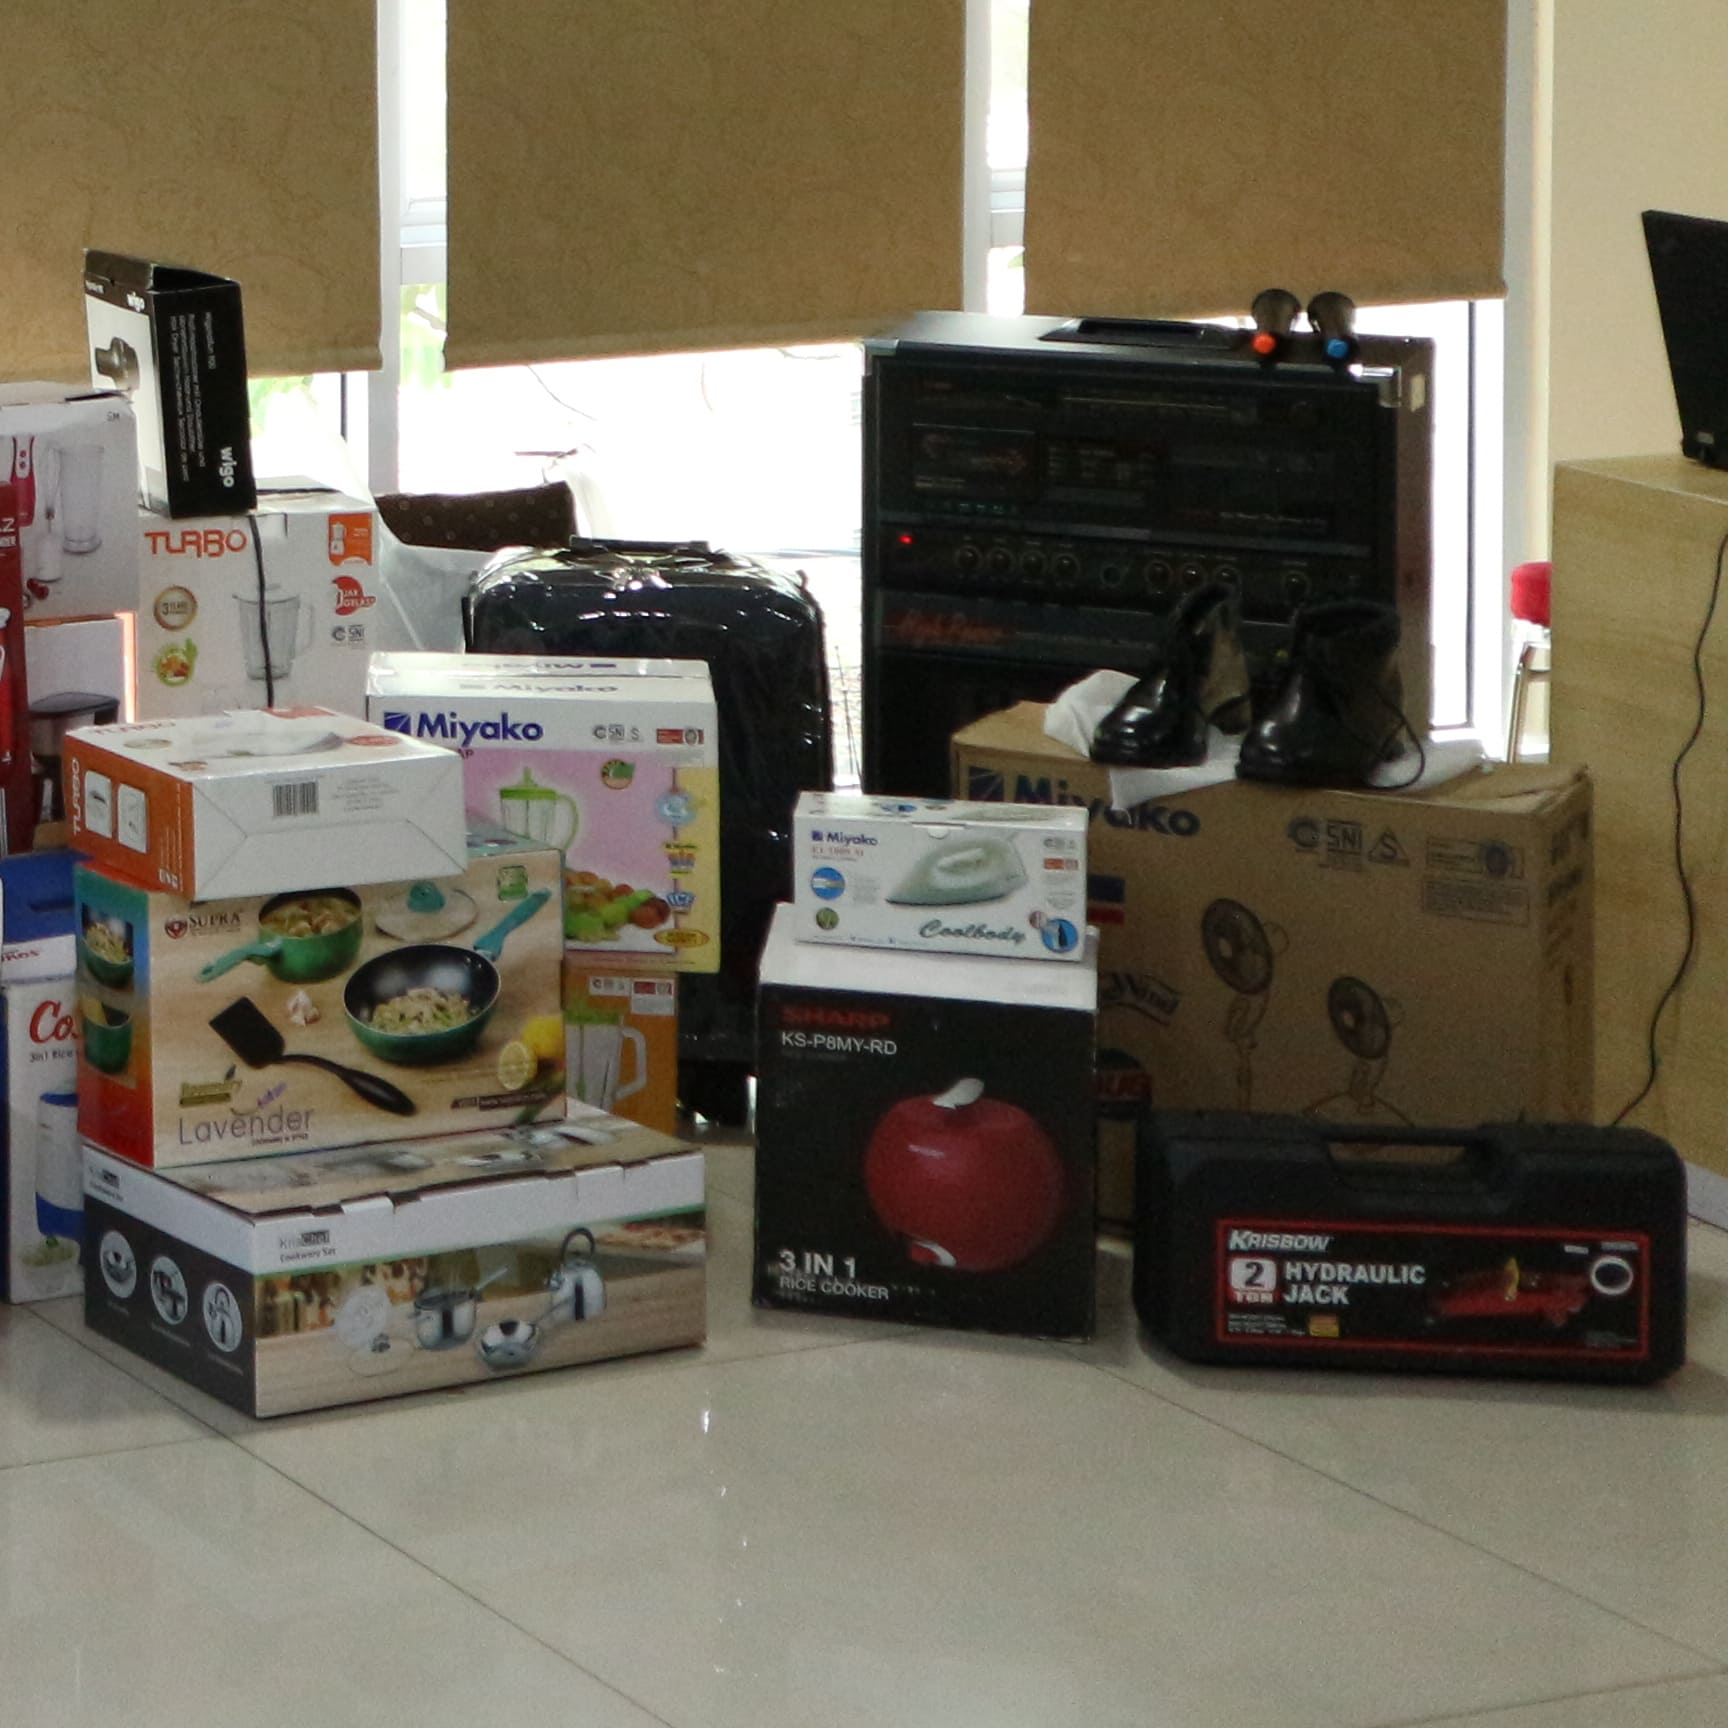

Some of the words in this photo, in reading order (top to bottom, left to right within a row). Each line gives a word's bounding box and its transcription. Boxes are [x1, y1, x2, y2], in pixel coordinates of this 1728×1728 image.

[219, 446, 237, 490] wigo
[144, 528, 248, 558] TURBO
[416, 711, 544, 747] Miyako
[827, 830, 879, 846] Miyako
[188, 912, 241, 928] SUPRA
[919, 918, 1026, 945] Coolbody
[782, 1006, 891, 1028] SHARP
[782, 1031, 898, 1057] KS-P8MY-RD
[178, 1105, 315, 1146] Lavender
[1228, 1228, 1330, 1252] KRISBOW
[777, 1249, 797, 1273] 3
[804, 1252, 834, 1275] IN
[845, 1256, 857, 1279] 1
[1244, 1261, 1265, 1288] 2
[1283, 1261, 1427, 1285] HYDRAULIC
[779, 1275, 816, 1294] RICE
[820, 1279, 890, 1301] COOKER
[1282, 1284, 1350, 1306] JACK
